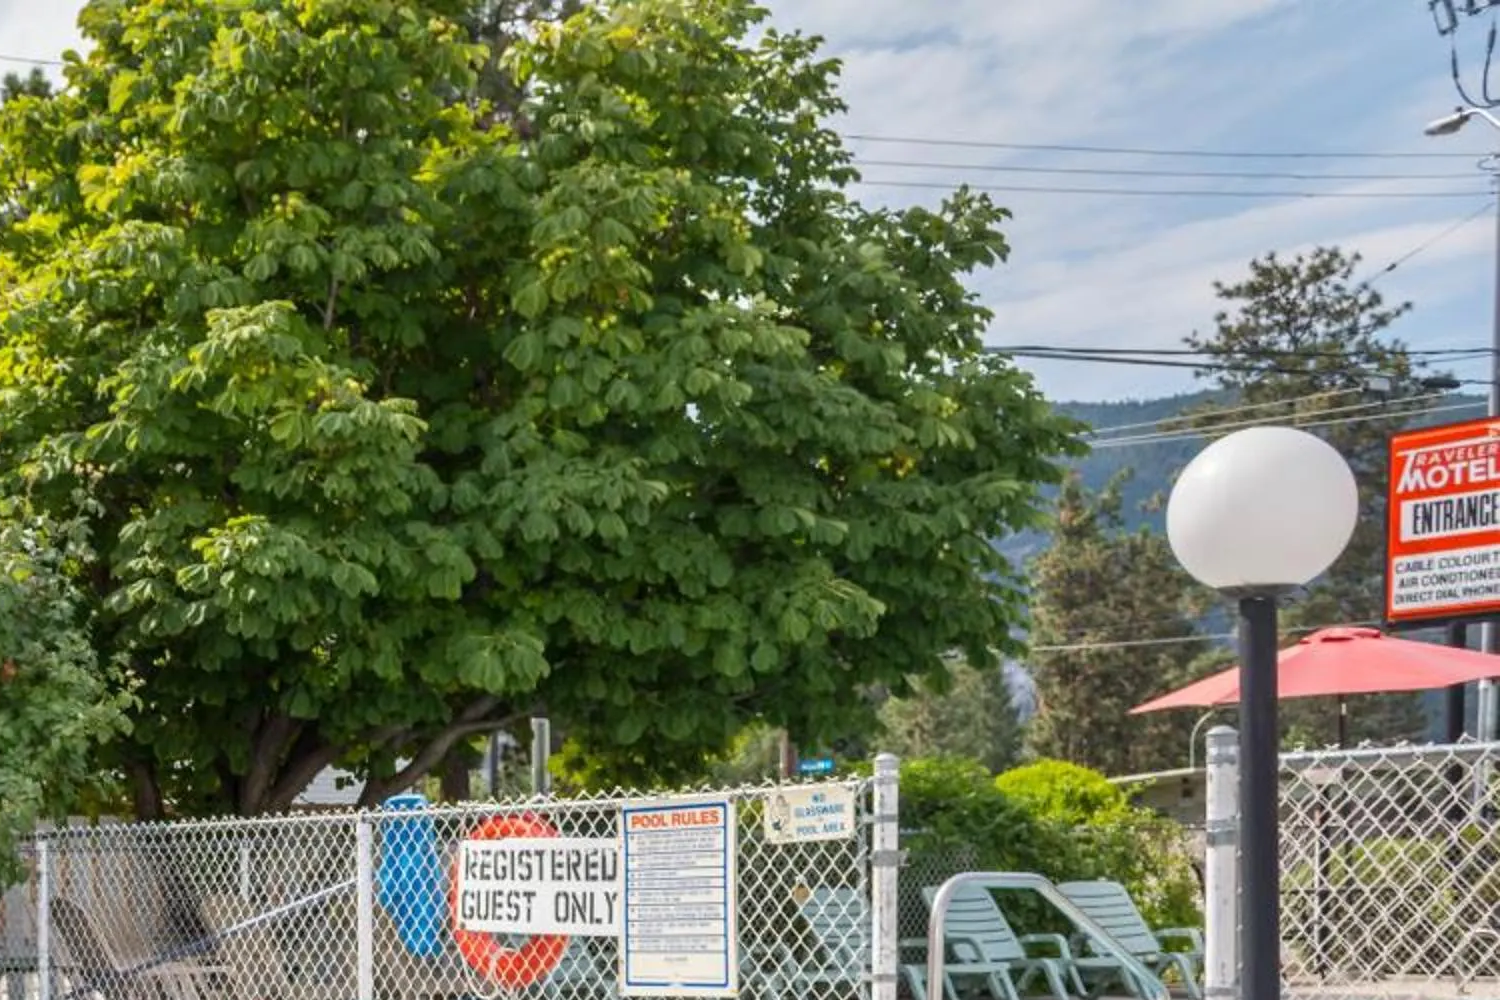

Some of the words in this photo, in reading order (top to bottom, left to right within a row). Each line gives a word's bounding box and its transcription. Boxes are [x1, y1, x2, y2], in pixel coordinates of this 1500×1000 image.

[1396, 457, 1500, 494] MOTEL
[1412, 491, 1500, 535] ENTRANCE
[631, 814, 667, 828] POOL
[671, 809, 720, 826] RULES
[465, 848, 617, 882] REGISTERED
[461, 889, 536, 922] GUEST
[554, 891, 618, 925] ONLY
